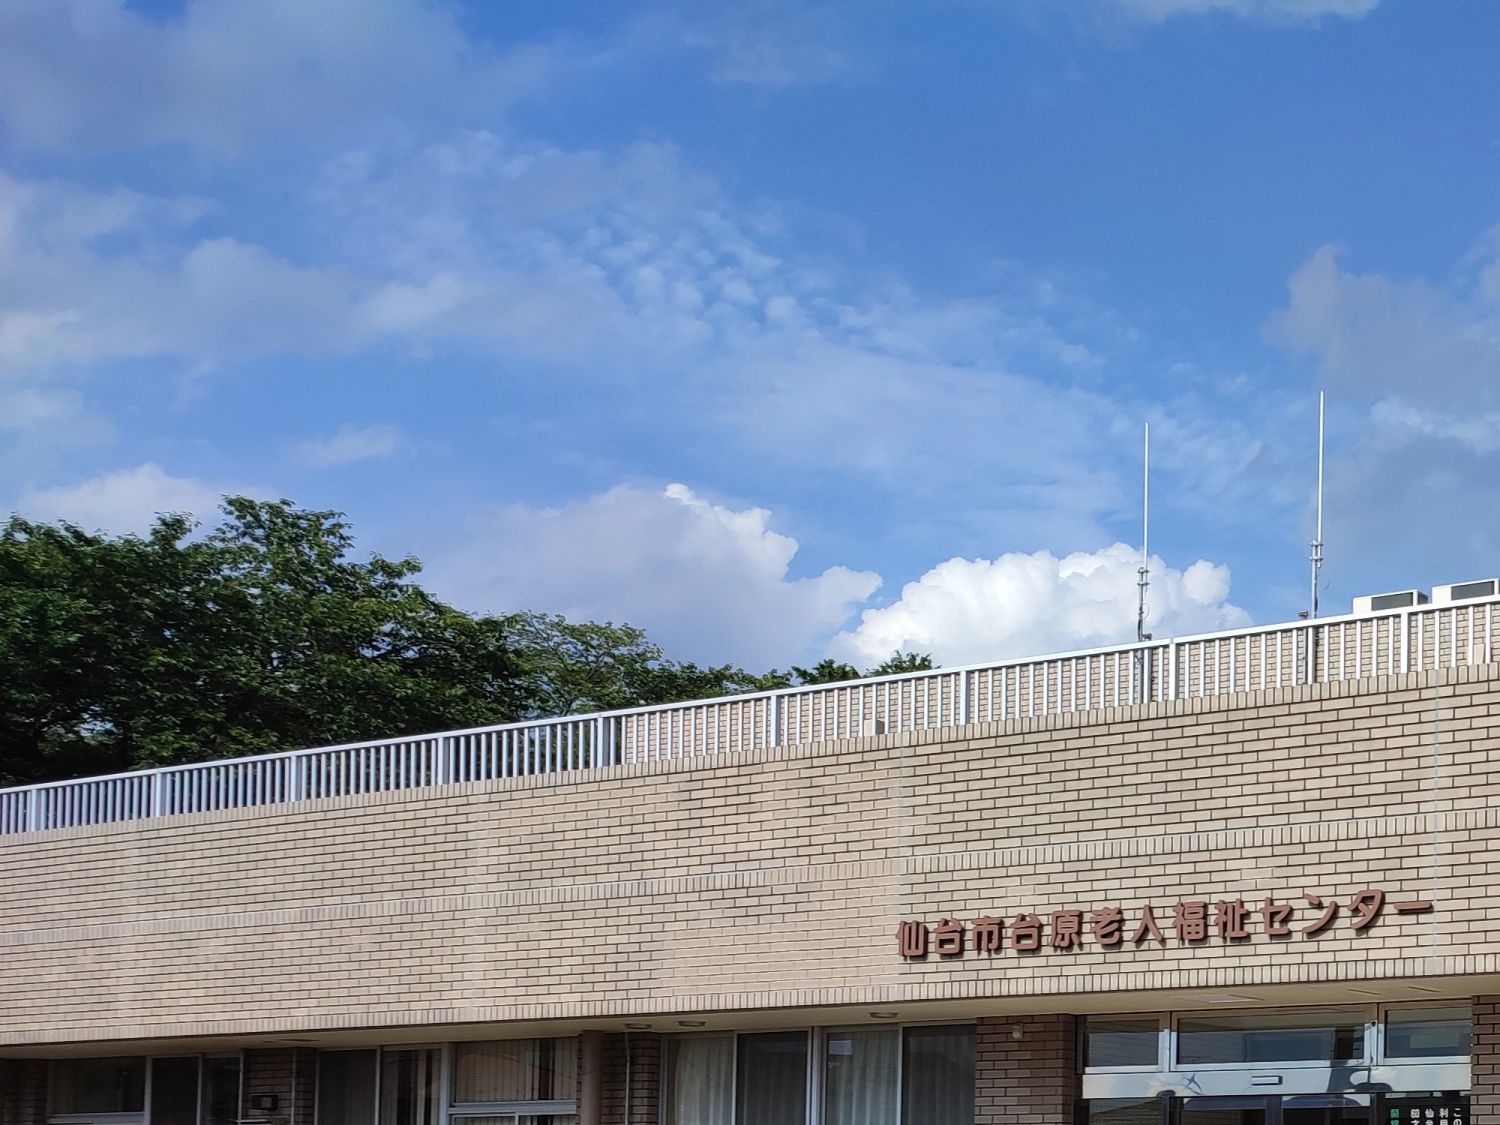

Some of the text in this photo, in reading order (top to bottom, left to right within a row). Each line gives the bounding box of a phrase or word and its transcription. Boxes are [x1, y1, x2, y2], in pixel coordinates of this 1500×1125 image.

[895, 889, 1432, 957] 仙台市台原老人福祉センター
